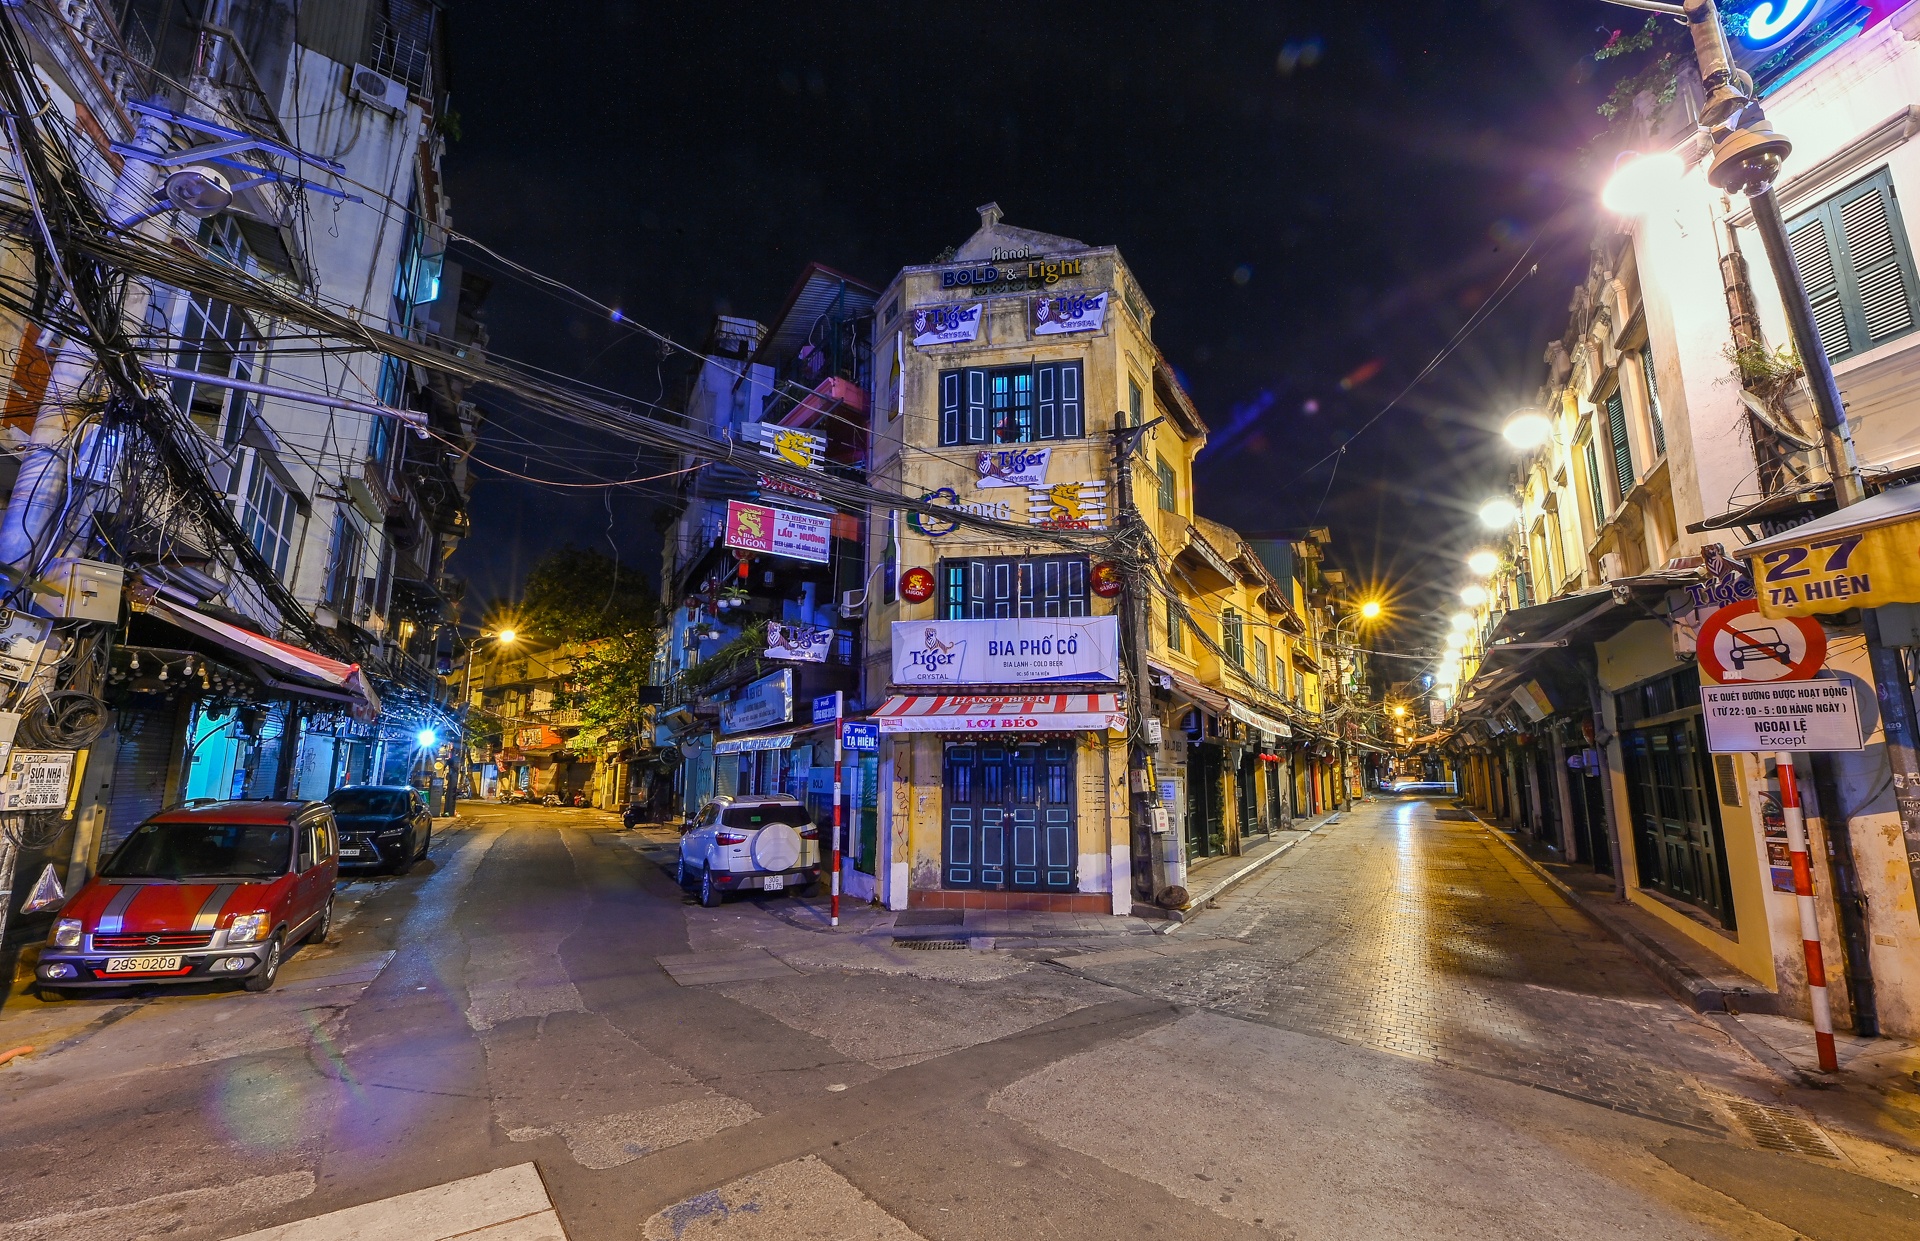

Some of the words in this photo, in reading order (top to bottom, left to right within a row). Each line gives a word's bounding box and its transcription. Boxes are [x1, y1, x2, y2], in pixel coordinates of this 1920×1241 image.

[992, 245, 1029, 261] Hanoi
[943, 267, 999, 287] BOLD
[1006, 269, 1017, 280] &
[1027, 258, 1081, 284] Light
[1056, 294, 1103, 320] Tiger
[931, 305, 977, 331] Tiger
[1060, 320, 1096, 328] CRYSTAL
[937, 330, 971, 340] CRYSTAL
[998, 448, 1045, 473] Tiger
[1004, 475, 1038, 483] CRYSTAL
[809, 518, 824, 526] VIEW
[730, 535, 767, 549] SAIGON
[1763, 534, 1863, 583] 27
[1685, 573, 1757, 608] Tige
[1768, 587, 1799, 607] TẠ
[1804, 574, 1871, 602] HIỆN
[786, 626, 830, 650] Tiger
[989, 640, 1015, 656] BIA
[1020, 635, 1053, 656] PHỐ
[1057, 633, 1078, 655] CỔ
[909, 649, 956, 672] Tiger
[1014, 661, 1028, 669] LẠNH
[955, 696, 1004, 705] HANOI
[1708, 693, 1718, 702] XE
[1720, 690, 1740, 702] QUÉT
[1742, 689, 1770, 700] ĐƯỜNG
[1773, 688, 1796, 700] ĐƯỢC
[1798, 688, 1820, 700] HOẠT
[1823, 687, 1848, 699] ĐỘNG
[1789, 702, 1813, 714] HÀNG
[1816, 701, 1840, 713] NGÀY
[854, 726, 867, 735] PHỐ
[966, 719, 996, 730] LỢI
[1001, 716, 1038, 729] BÉO
[1755, 720, 1790, 733] NGOẠI
[1794, 718, 1807, 733] LỆ
[847, 736, 856, 748] TẠ
[857, 734, 875, 749] HIỆN
[1759, 735, 1807, 746] Except
[813, 779, 823, 788] BOLD
[112, 957, 176, 971] 29S-0209
